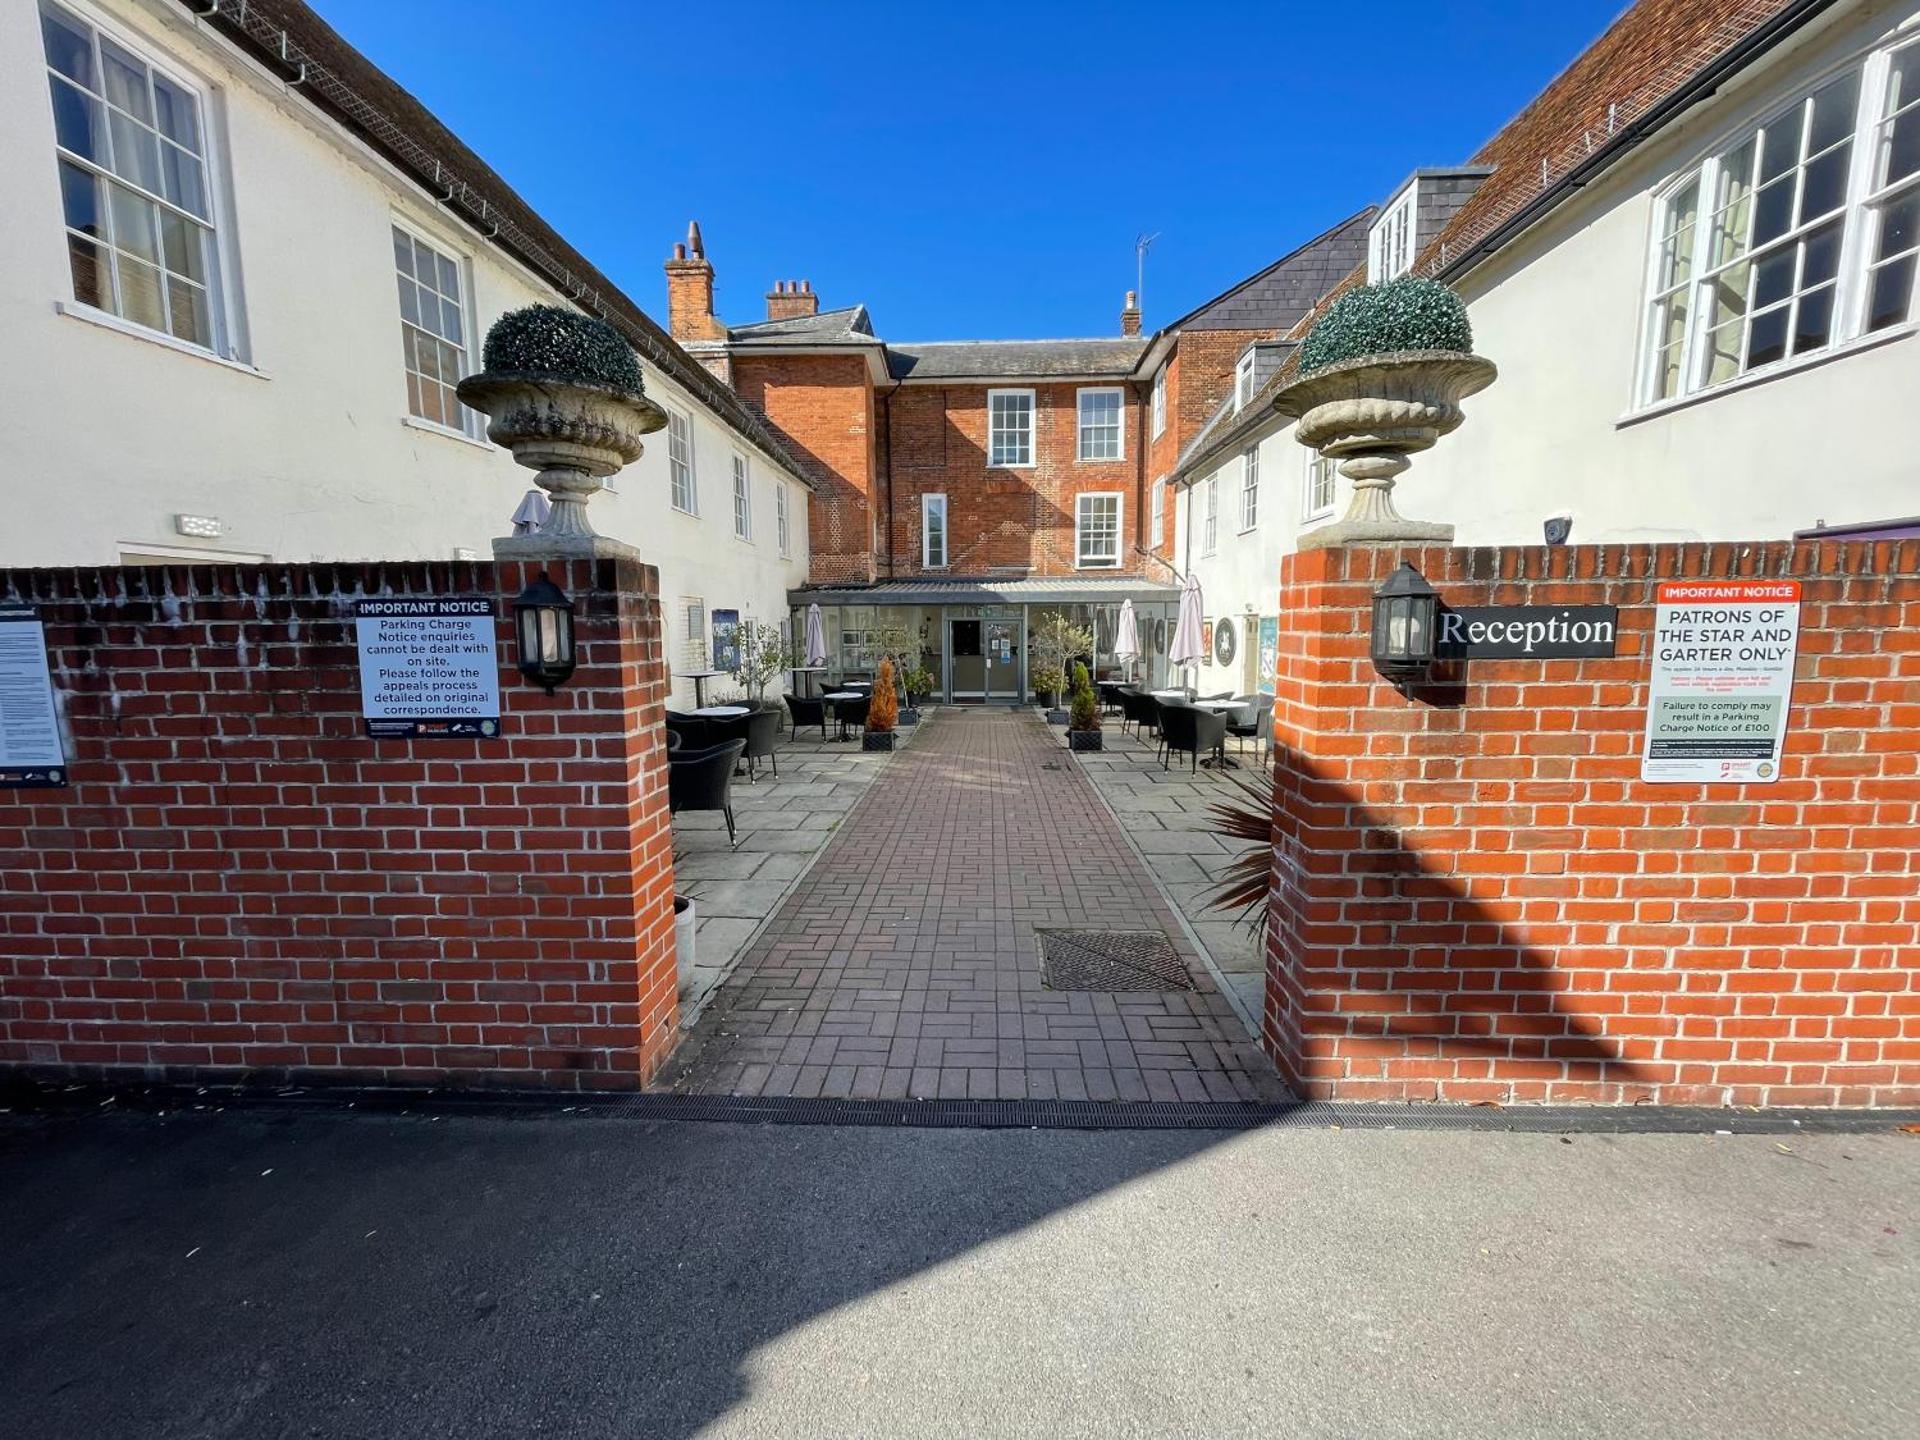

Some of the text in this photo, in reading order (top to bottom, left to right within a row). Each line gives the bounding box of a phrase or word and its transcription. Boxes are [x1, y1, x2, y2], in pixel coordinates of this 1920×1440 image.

[1666, 586, 1793, 597] IMPORTANT NOTICE
[361, 602, 488, 613] IMPORTANT NOTICE
[1669, 610, 1785, 623] PATRONS OF
[380, 620, 472, 630] Parking Charge
[1439, 611, 1614, 652] Reception
[1660, 629, 1792, 642] THE STAR AND
[378, 632, 475, 643] Notice enquiries
[367, 644, 489, 654] cannot be dealt with
[1660, 649, 1731, 661] GARTER
[408, 656, 449, 666] on site.
[379, 668, 479, 678] Please follow the
[384, 681, 477, 691] appeals process
[374, 692, 489, 703] detailed on original
[384, 705, 481, 715] correspondence.
[1663, 702, 1695, 710] Failure
[1711, 702, 1747, 711] comply
[1660, 724, 1769, 733] Charge Notice of £100
